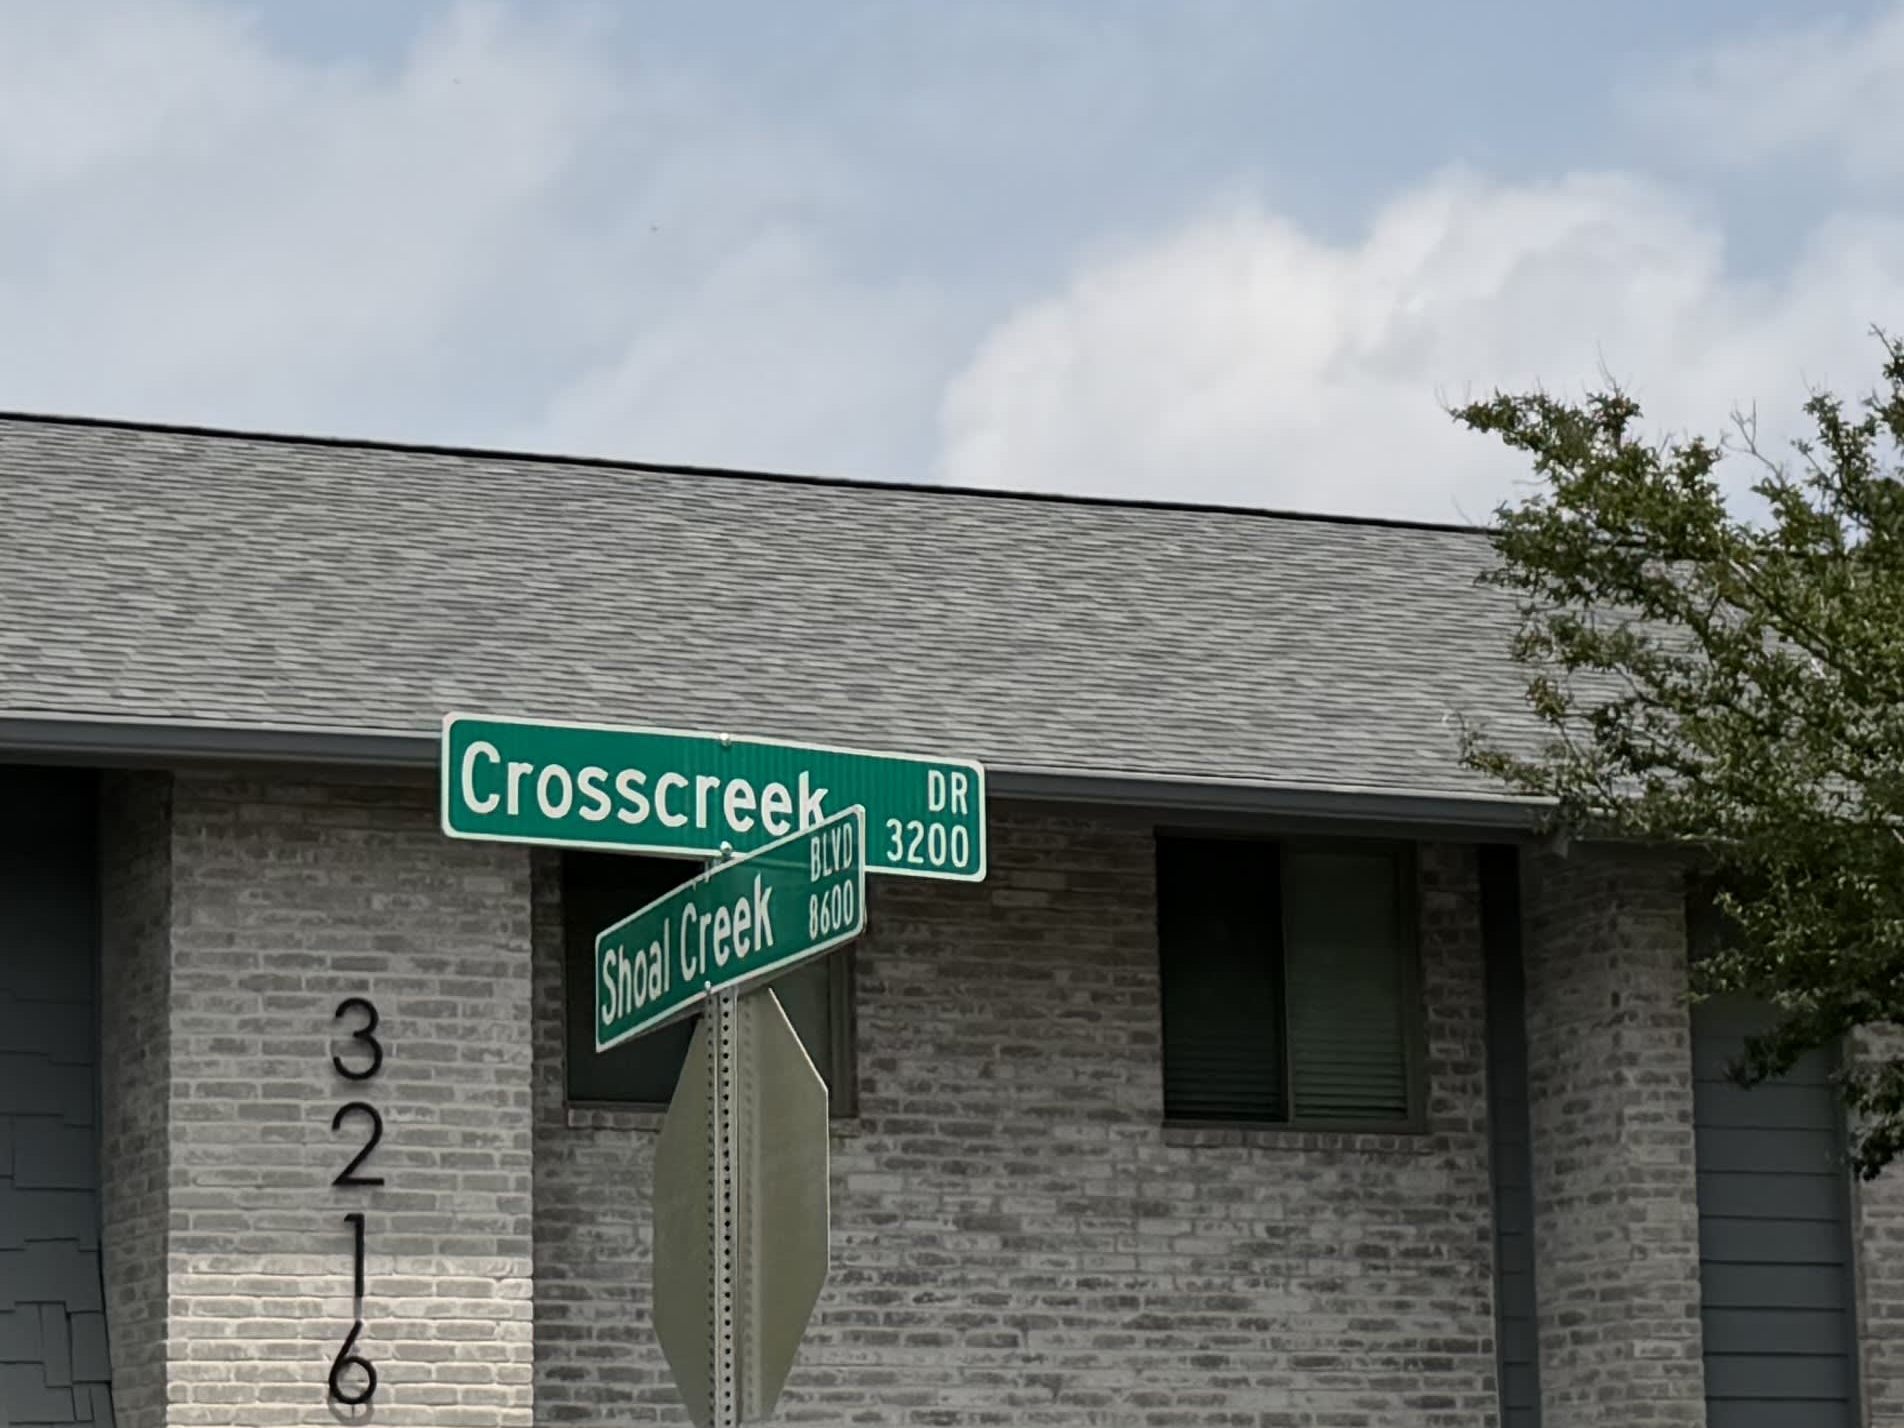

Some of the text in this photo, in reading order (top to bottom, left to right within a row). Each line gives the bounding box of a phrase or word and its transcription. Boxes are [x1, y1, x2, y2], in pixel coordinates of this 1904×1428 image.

[461, 740, 969, 836] Crosscreek DR
[885, 818, 971, 869] 3200
[600, 821, 854, 1026] Shoal Creek BLVD
[808, 883, 855, 942] 8600
[328, 997, 385, 1405] 3216
